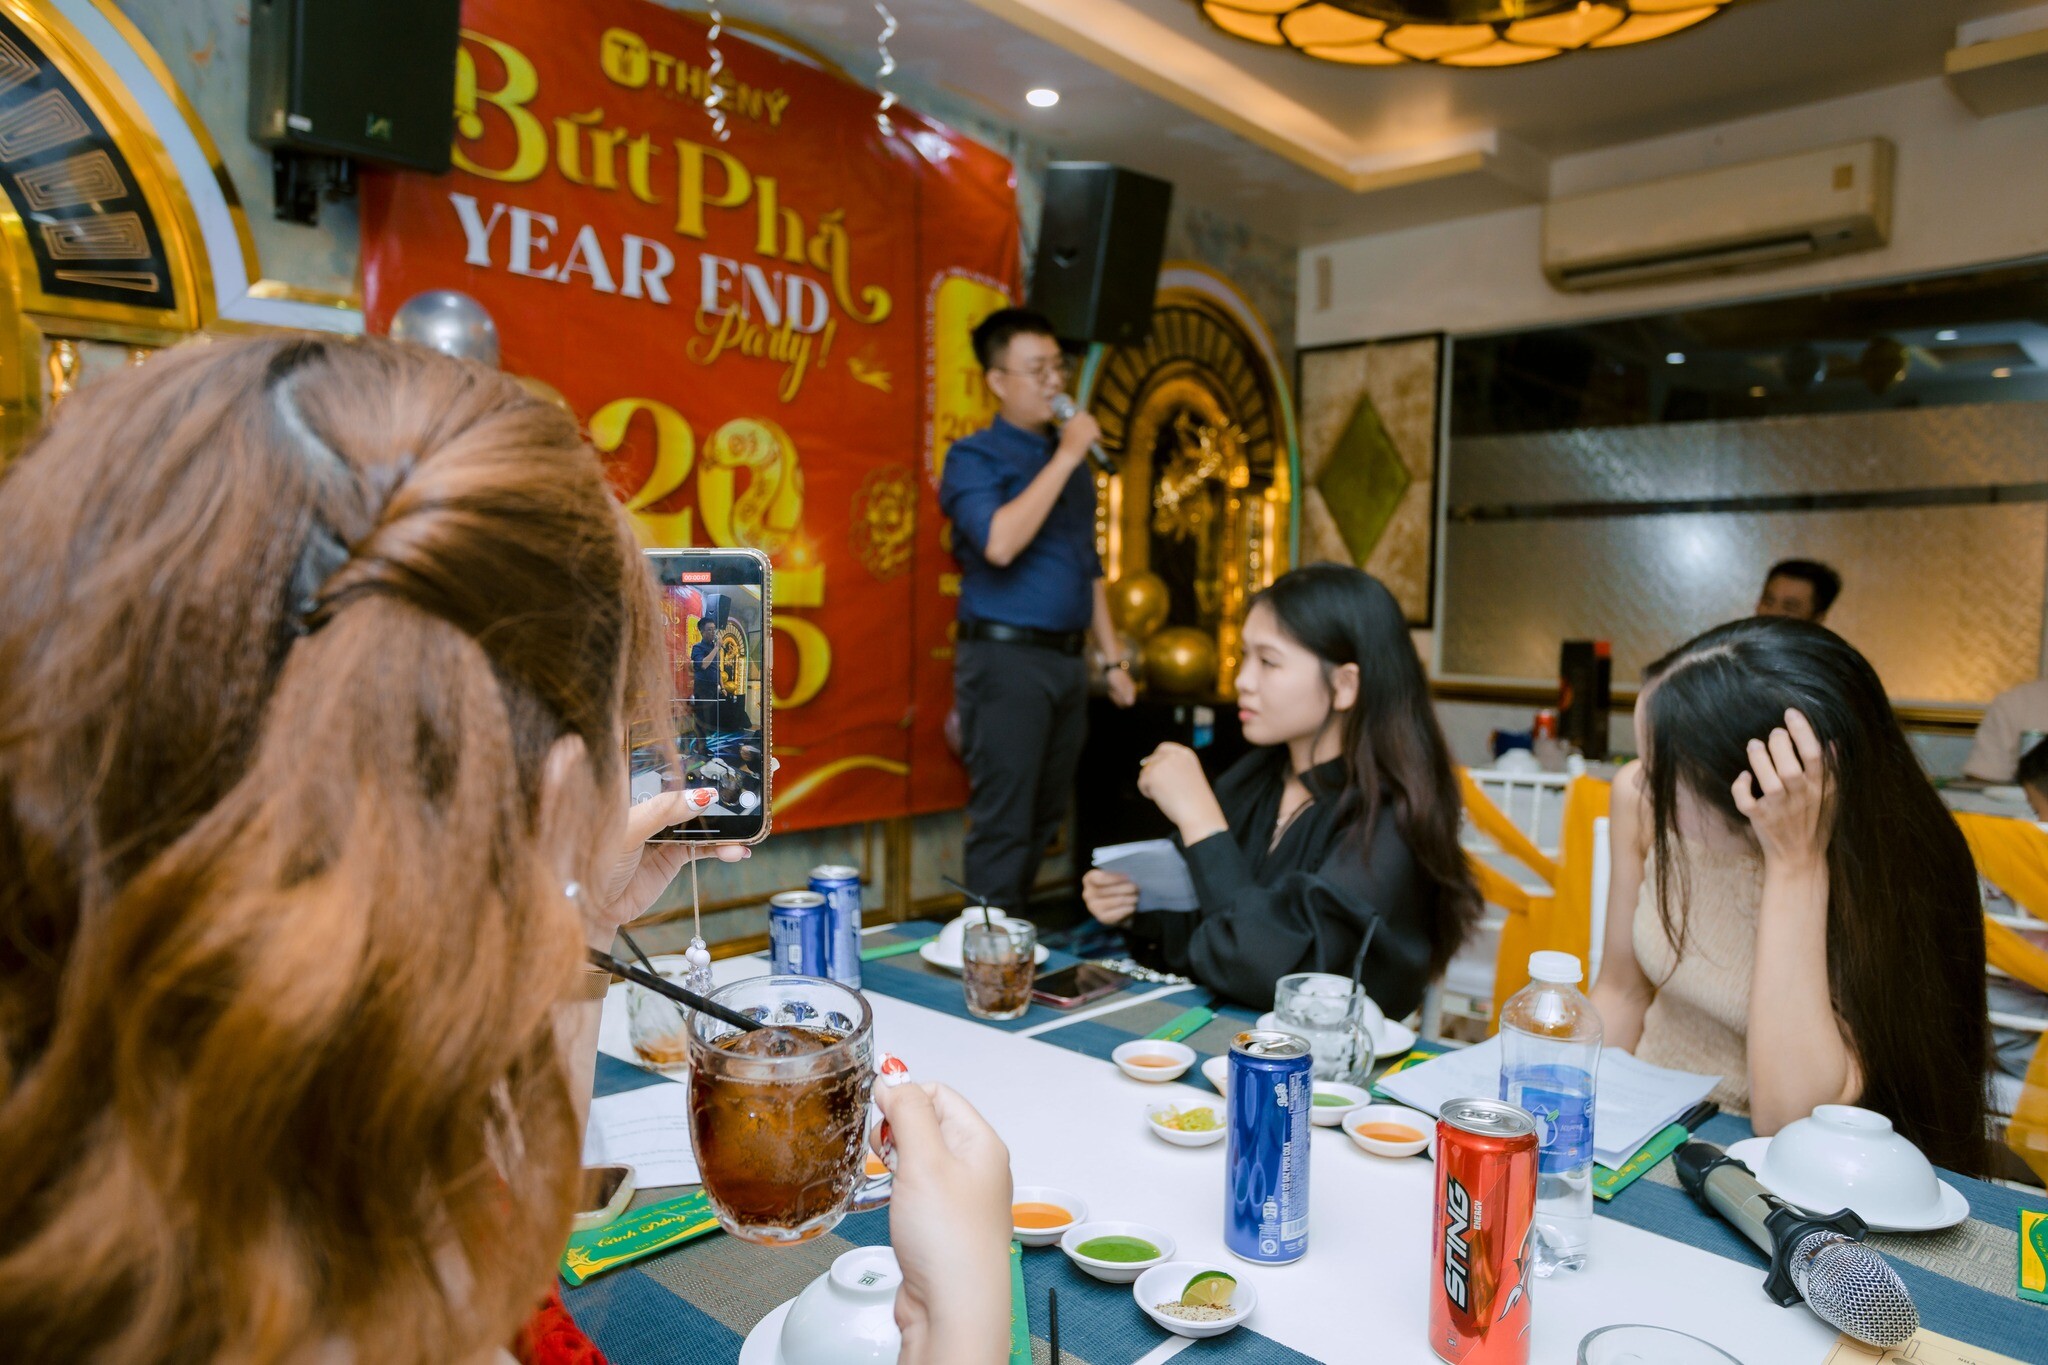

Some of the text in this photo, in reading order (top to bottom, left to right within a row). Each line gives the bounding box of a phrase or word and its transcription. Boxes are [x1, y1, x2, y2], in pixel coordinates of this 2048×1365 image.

[451, 27, 893, 324] Bứt Phá
[449, 192, 830, 334] YEAR END
[1282, 1156, 1292, 1171] PEPSI
[1283, 1141, 1292, 1156] COLA
[1444, 1178, 1470, 1310] STING
[1473, 1200, 1482, 1230] ENERGY
